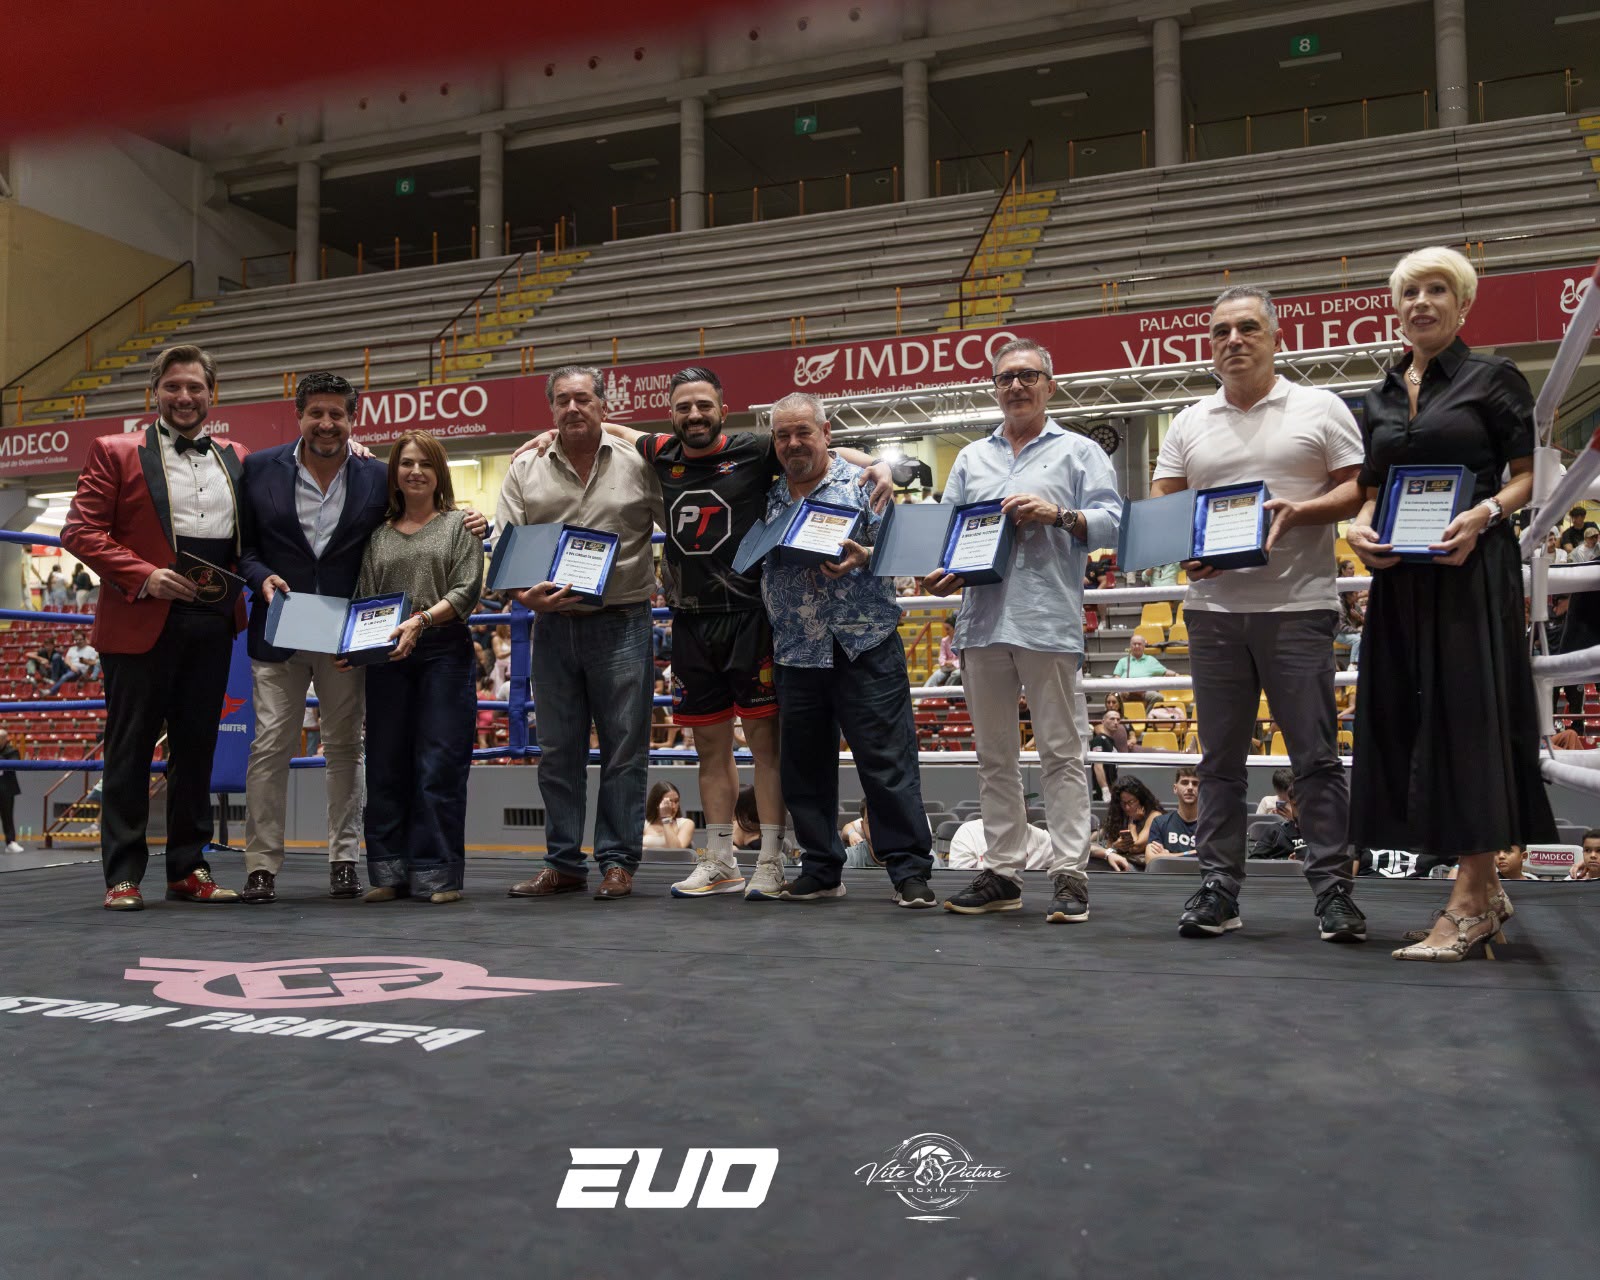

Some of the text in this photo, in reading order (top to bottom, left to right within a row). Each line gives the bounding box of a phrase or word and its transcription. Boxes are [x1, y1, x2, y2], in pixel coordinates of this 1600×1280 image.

[1299, 38, 1311, 52] 8
[802, 118, 810, 131] 7
[401, 180, 409, 193] 6
[1321, 295, 1393, 315] DEPORT
[1121, 334, 1212, 368] VIST
[634, 373, 674, 392] AYUNTA
[634, 390, 671, 410] DE CÓR
[447, 423, 486, 435] Córdoba
[677, 505, 723, 539] PT
[1168, 832, 1197, 847] BOS
[1539, 852, 1574, 861] IMDECO
[166, 1010, 486, 1052] FIGHTER
